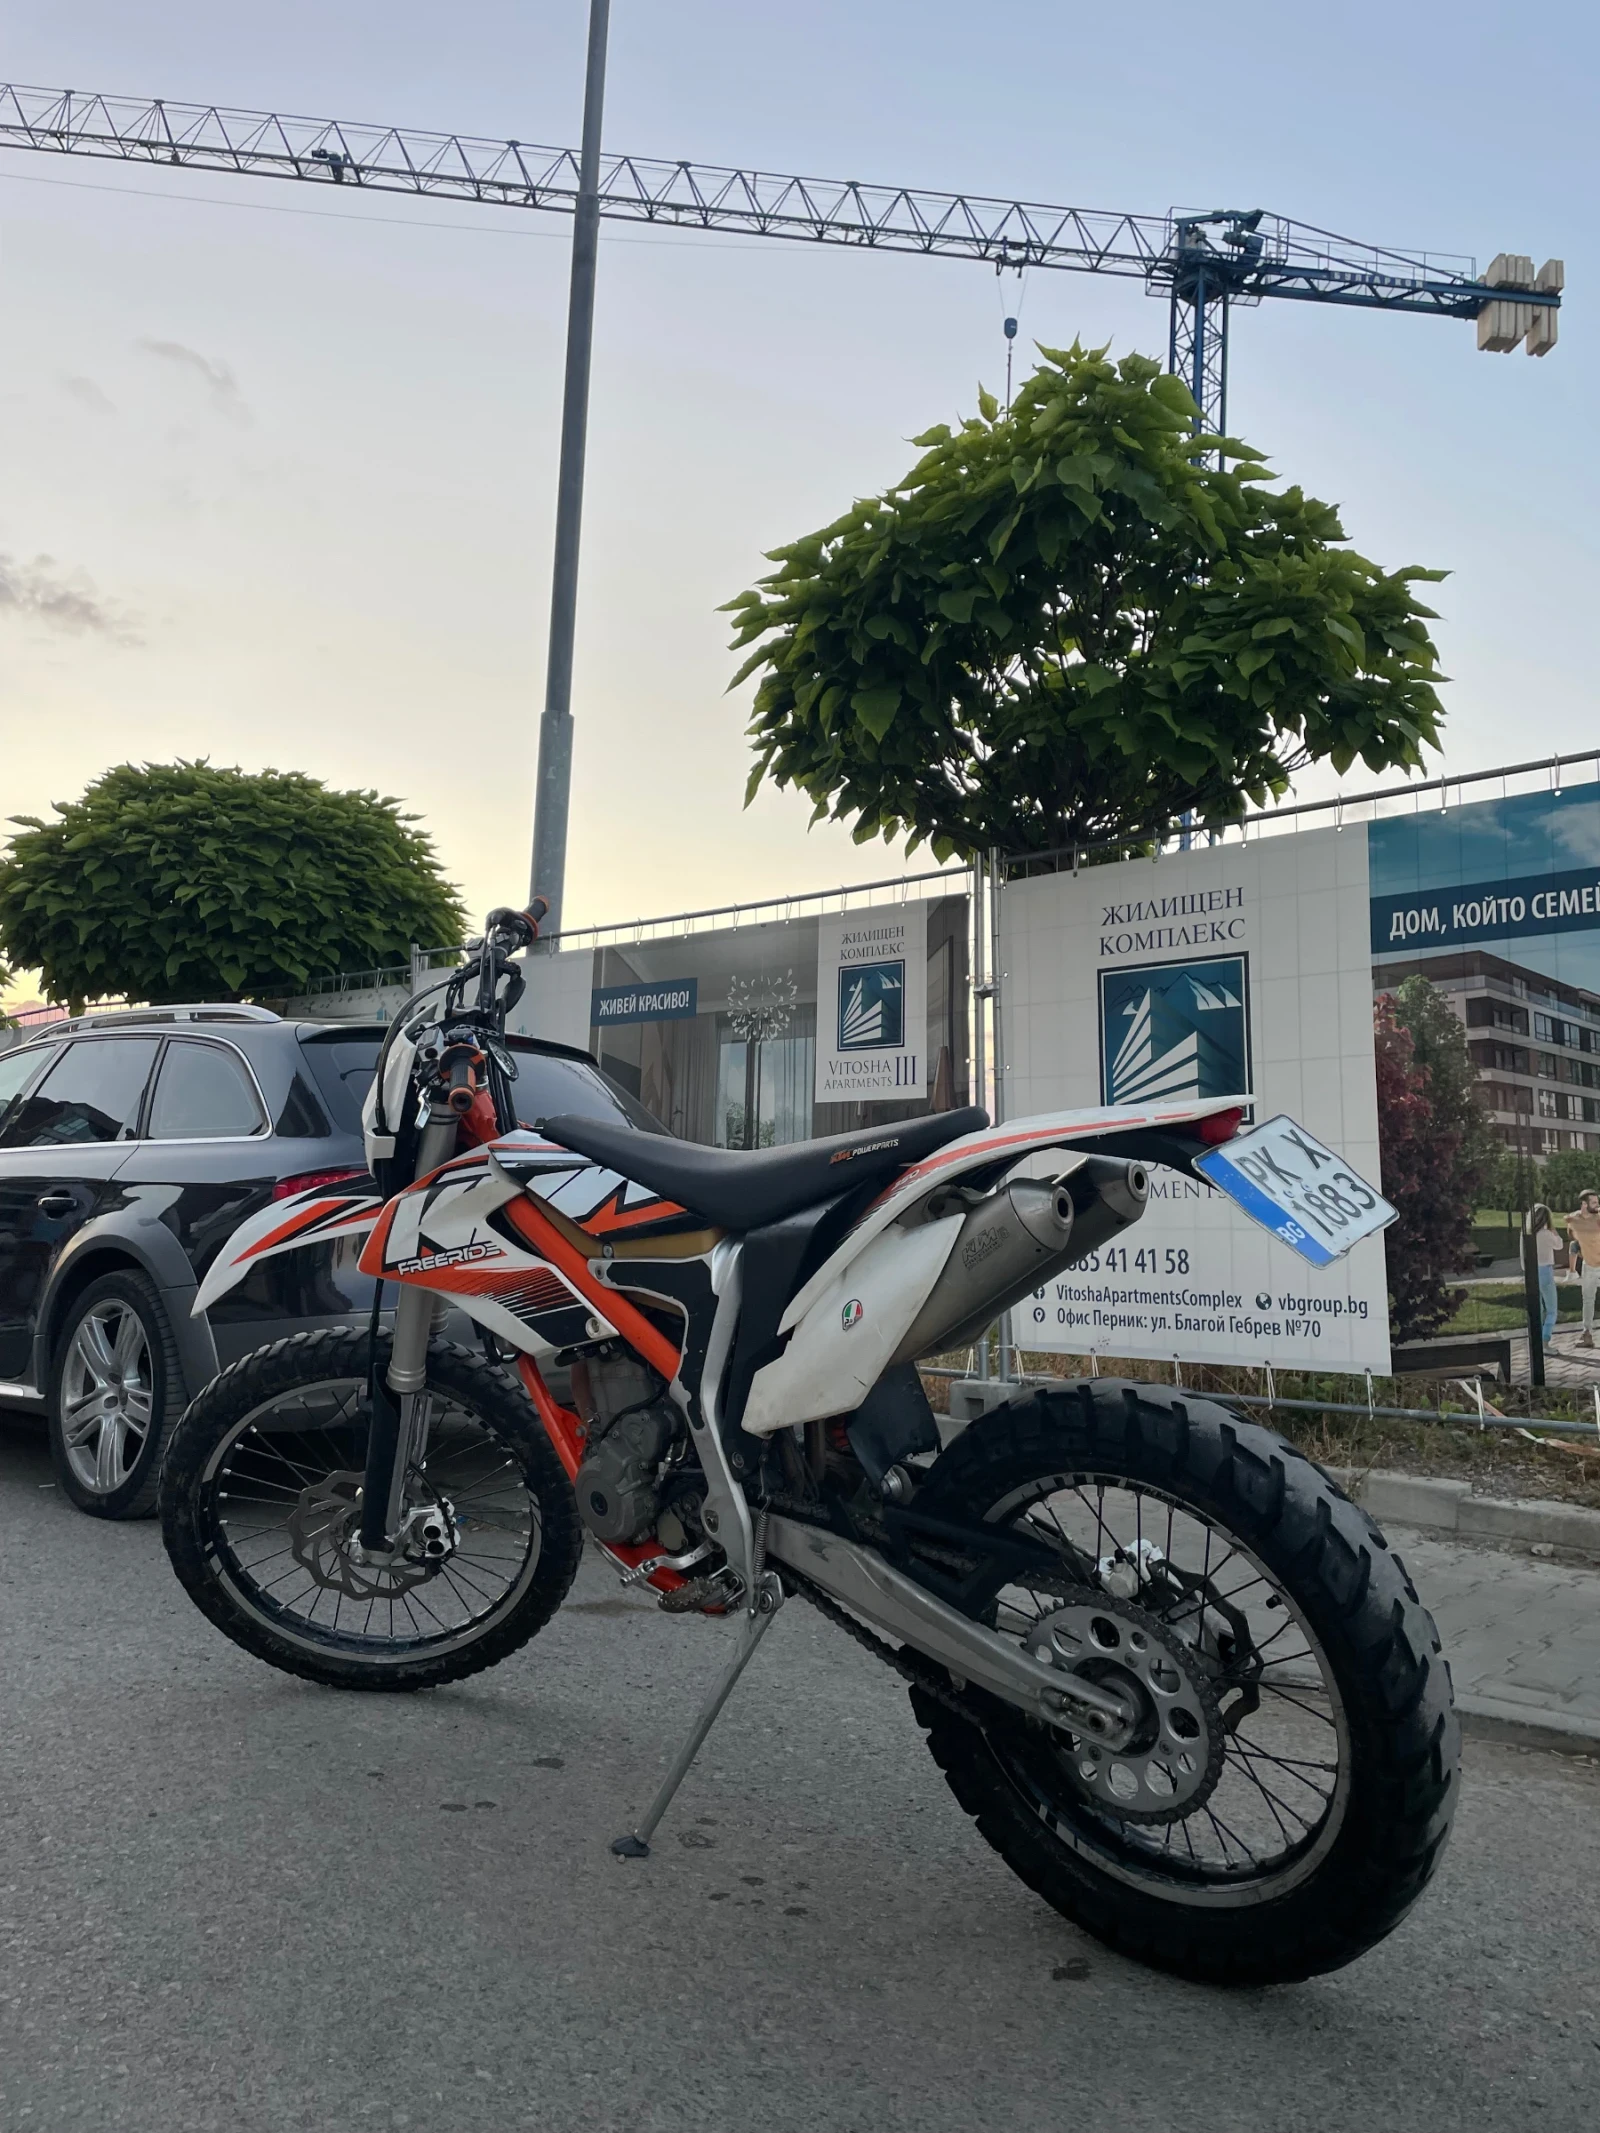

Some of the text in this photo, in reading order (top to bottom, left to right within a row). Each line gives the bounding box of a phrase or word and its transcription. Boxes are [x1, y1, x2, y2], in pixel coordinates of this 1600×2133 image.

[1101, 887, 1244, 927] ЖИЛИЩЕН
[1389, 907, 1447, 941] ДОМ,
[1453, 896, 1526, 929] КОЙТО
[840, 942, 905, 960] КОМПЛЕКС
[841, 926, 905, 945] ЖИЛИЩЕН
[1099, 918, 1246, 956] КОМПЛЕКС
[599, 990, 690, 1016] ЖИВЕЙ КРАСИВО!
[895, 1055, 918, 1086] III
[1233, 1146, 1303, 1195] PK
[1292, 1172, 1376, 1237] 1883
[1276, 1221, 1306, 1245] BG
[397, 1244, 502, 1276] FREERIDE
[1105, 1248, 1127, 1273] 41
[1134, 1248, 1157, 1274] 41
[1165, 1249, 1190, 1275] 58
[1056, 1284, 1368, 1319] VitoshaApartmentsComplex vbgroup.bg
[1057, 1307, 1321, 1339] Офис Перник: ул. Благой Гебрев №70
